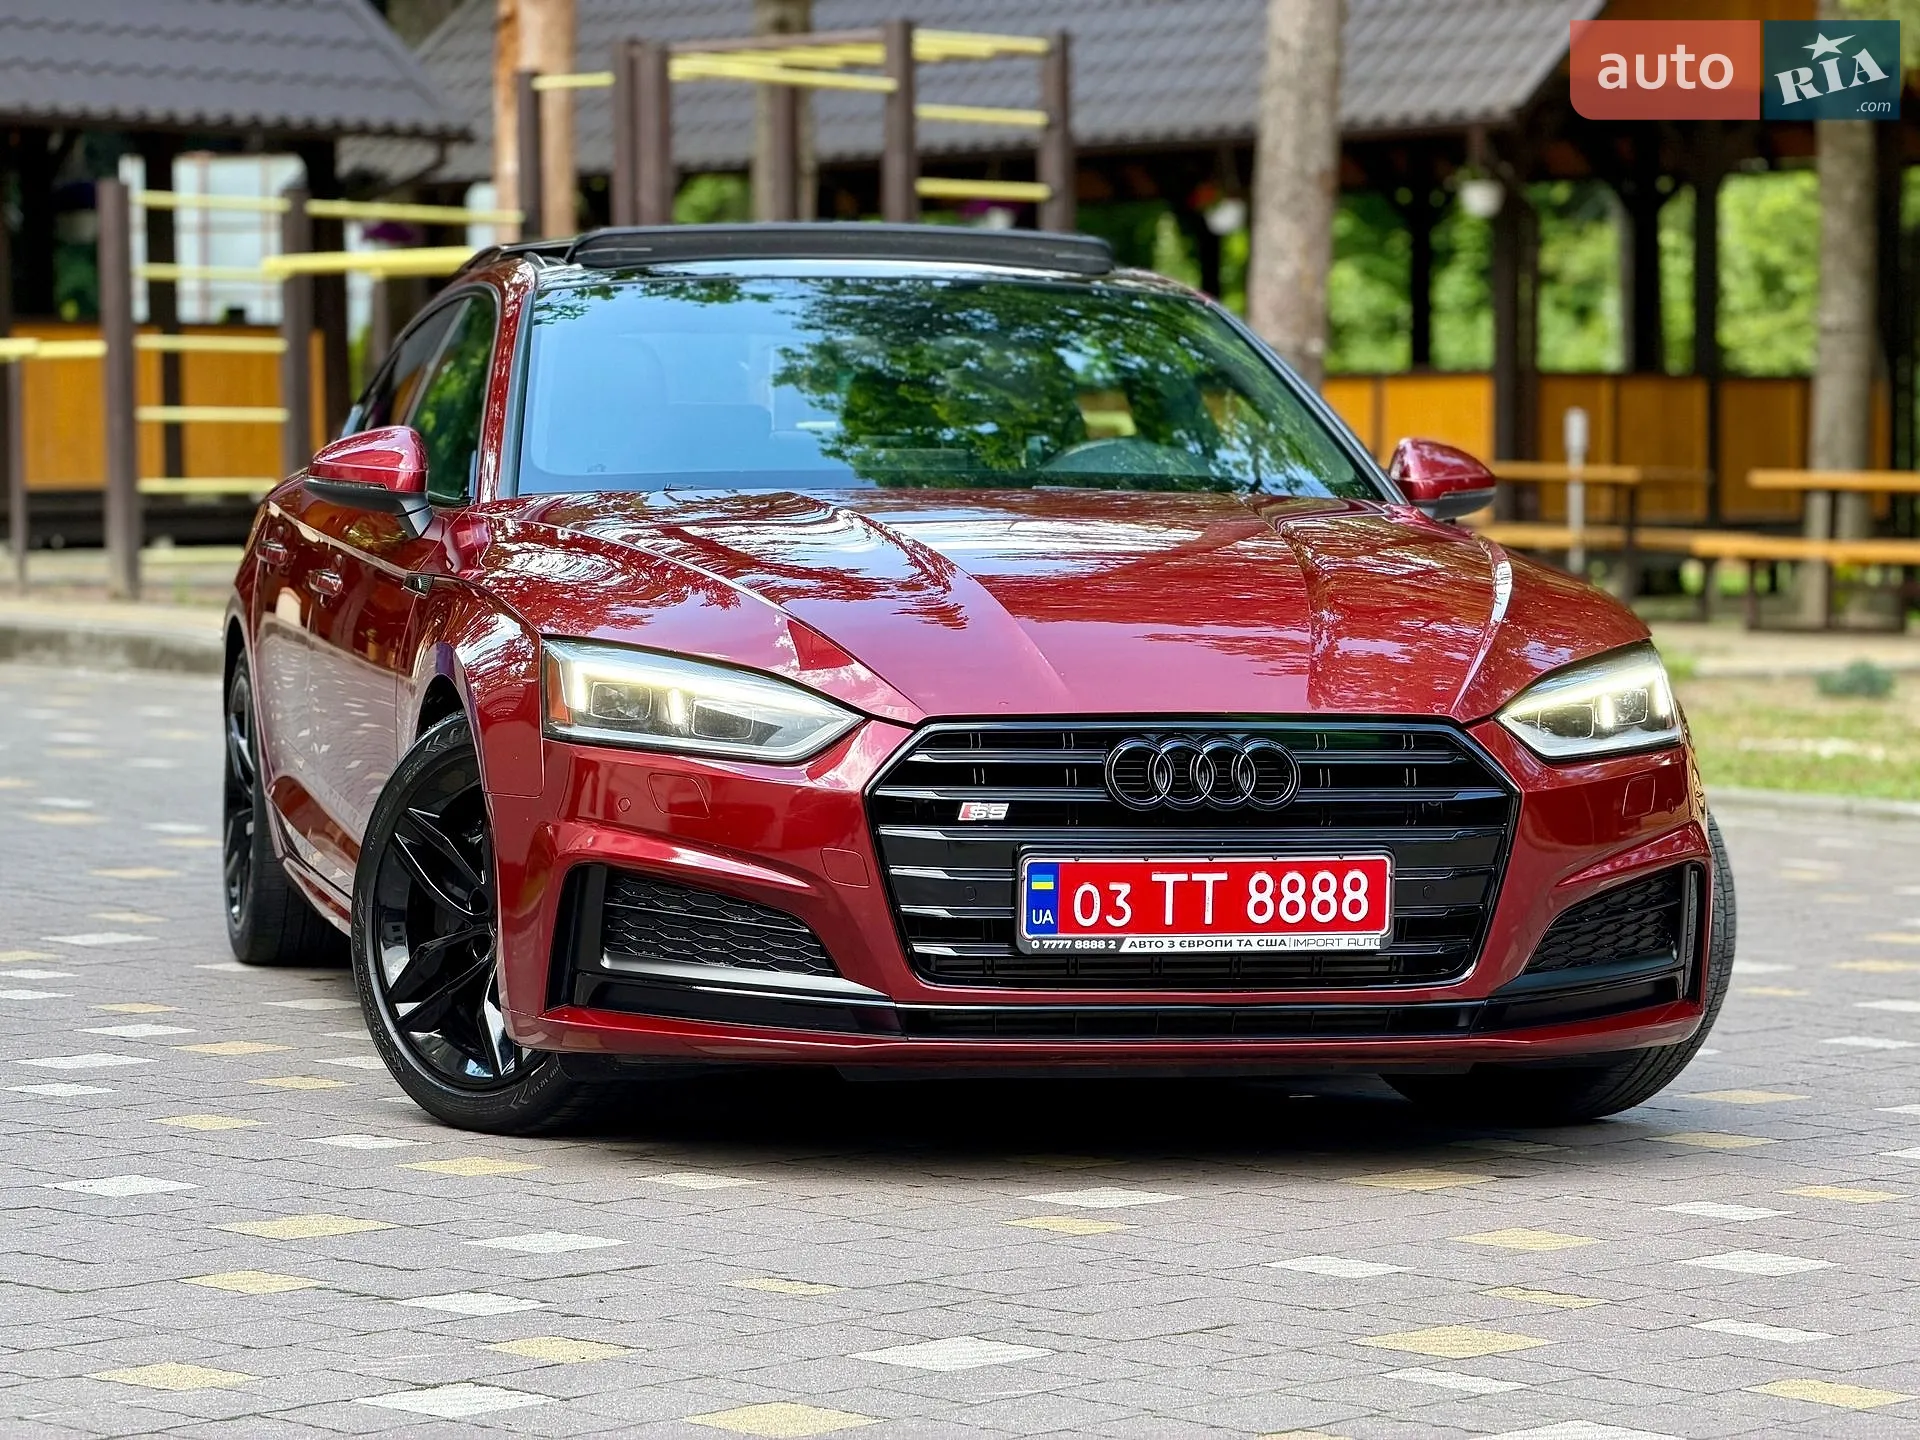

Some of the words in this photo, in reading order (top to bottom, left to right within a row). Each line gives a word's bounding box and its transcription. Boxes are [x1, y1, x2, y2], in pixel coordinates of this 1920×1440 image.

[1073, 882, 1132, 927] 03
[1151, 871, 1228, 926] TT
[1246, 870, 1369, 924] 8888
[1032, 910, 1054, 925] UA
[1031, 939, 1040, 949] 0
[1043, 939, 1072, 949] 7777
[1075, 939, 1106, 949] 8888
[1128, 940, 1165, 949] АВТО
[1179, 939, 1233, 948] ЄВРОПИ
[1237, 939, 1253, 947] ТА
[1256, 938, 1287, 947] США
[1293, 937, 1343, 948] IMPORT
